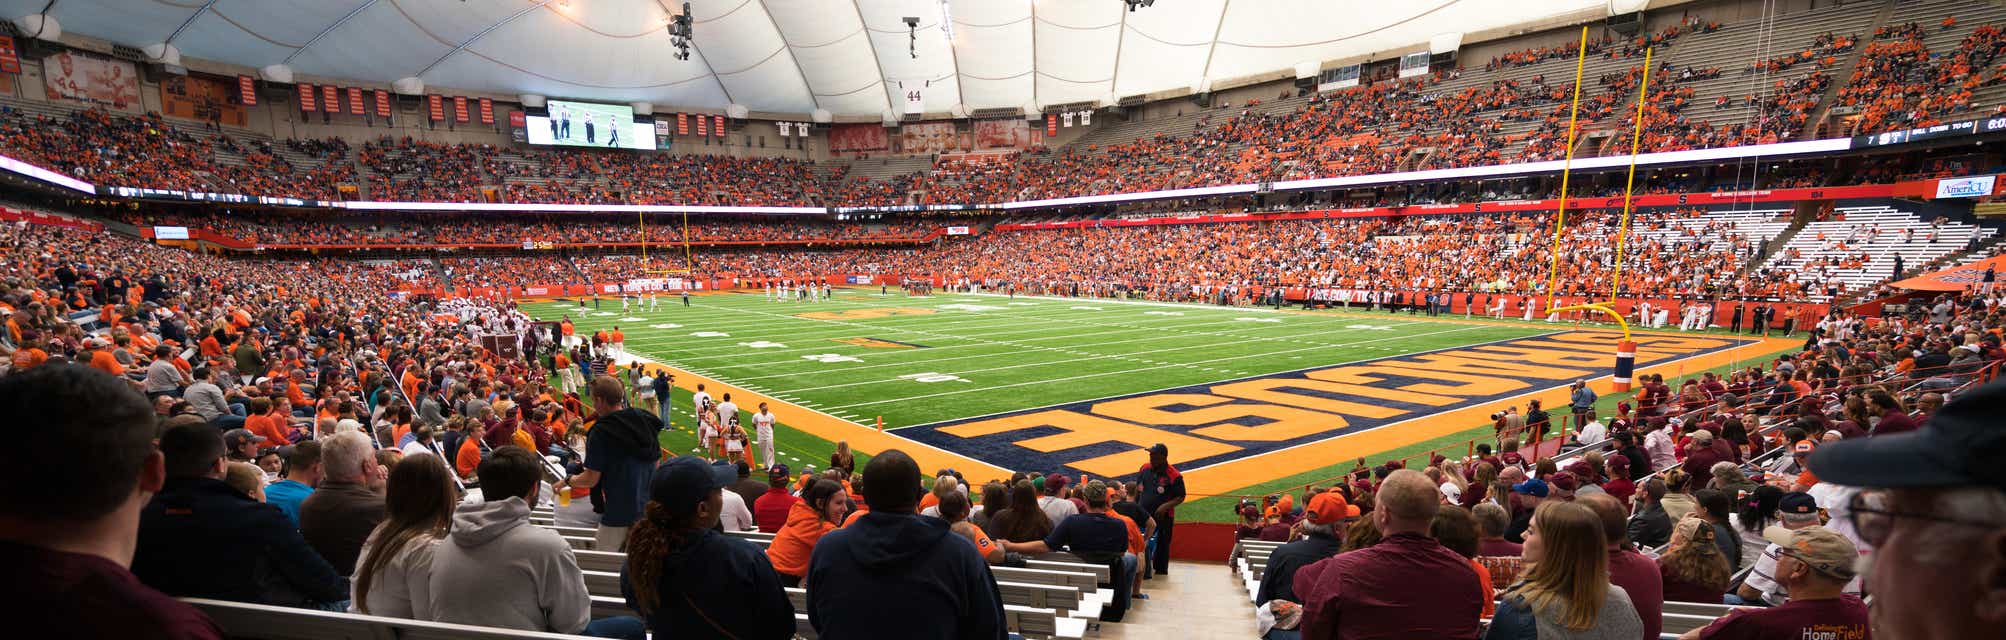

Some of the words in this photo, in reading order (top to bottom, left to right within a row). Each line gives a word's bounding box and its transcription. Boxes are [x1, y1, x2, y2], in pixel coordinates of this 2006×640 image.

[907, 90, 921, 101] 44
[1988, 118, 2006, 129] 6:0
[933, 331, 1735, 478] SYRACUSE
